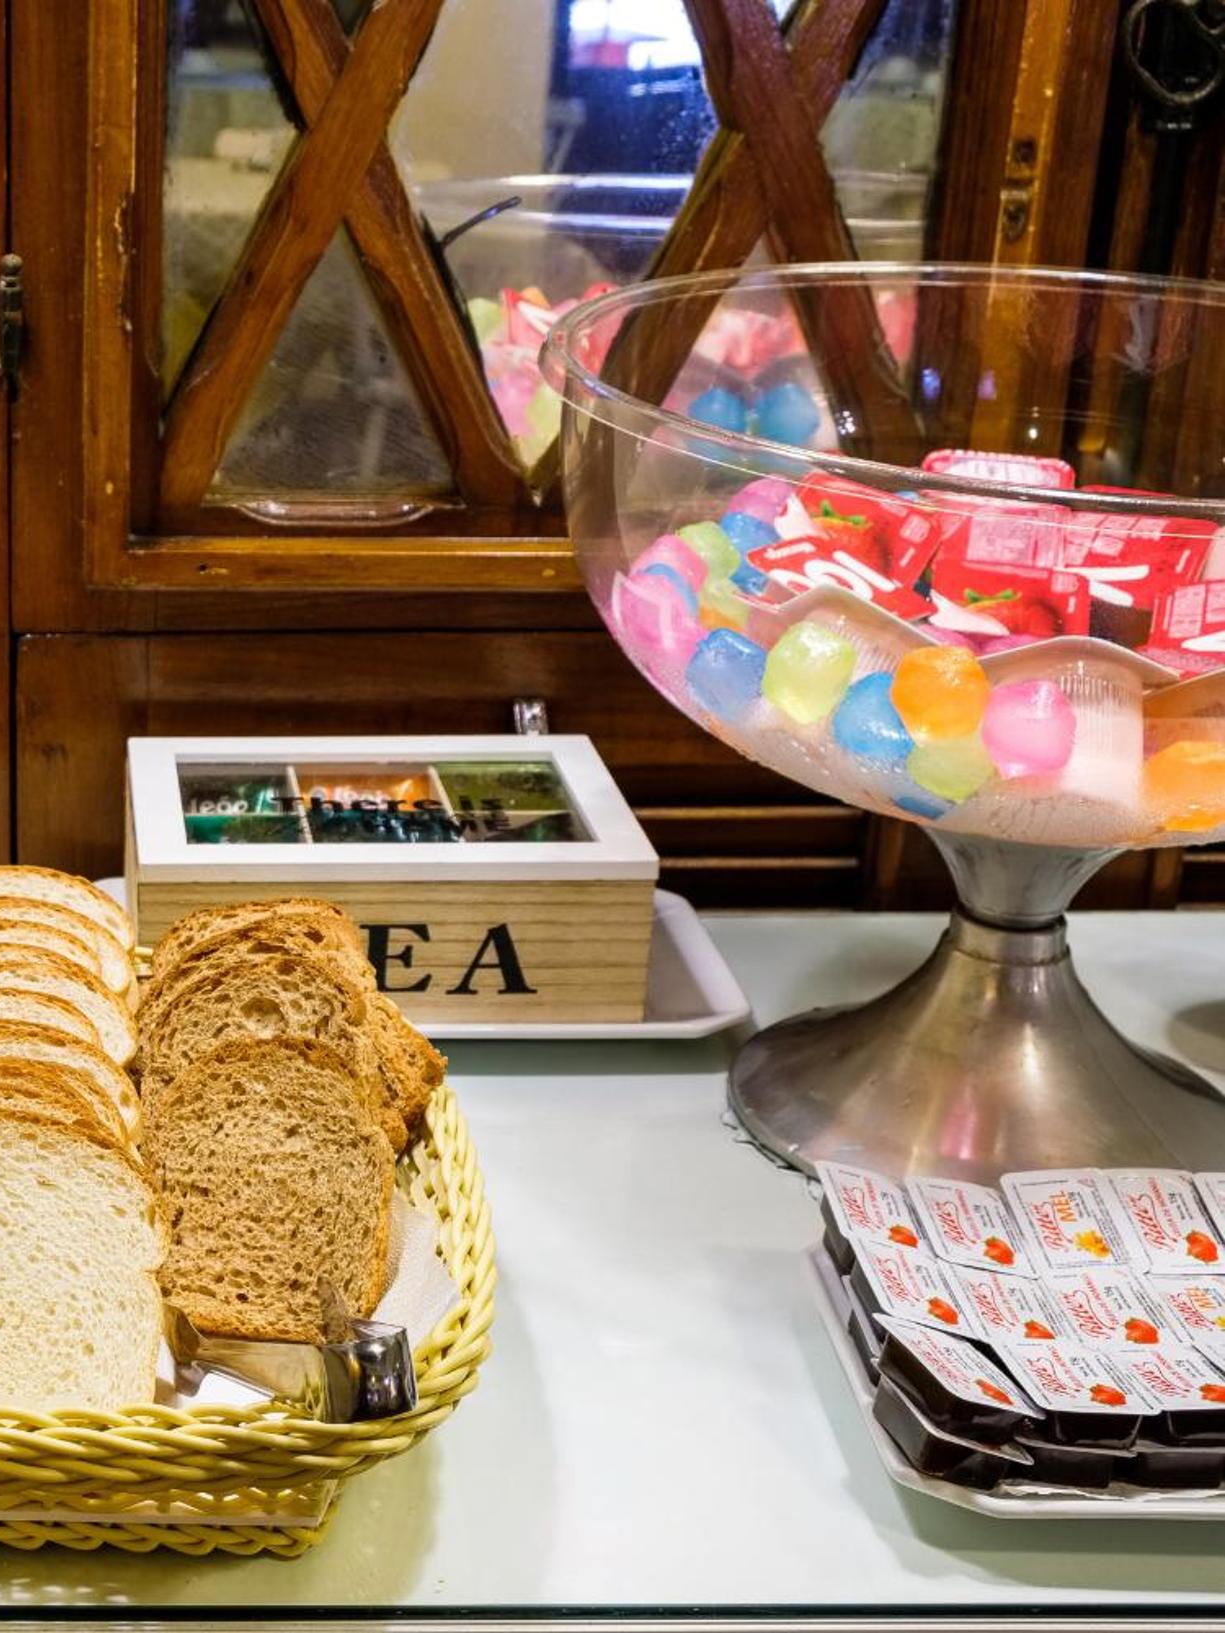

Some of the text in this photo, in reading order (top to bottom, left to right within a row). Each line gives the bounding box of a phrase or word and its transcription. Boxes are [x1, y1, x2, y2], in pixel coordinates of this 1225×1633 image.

[271, 795, 445, 813] There
[359, 922, 538, 996] EA
[1049, 1190, 1079, 1224] MEL
